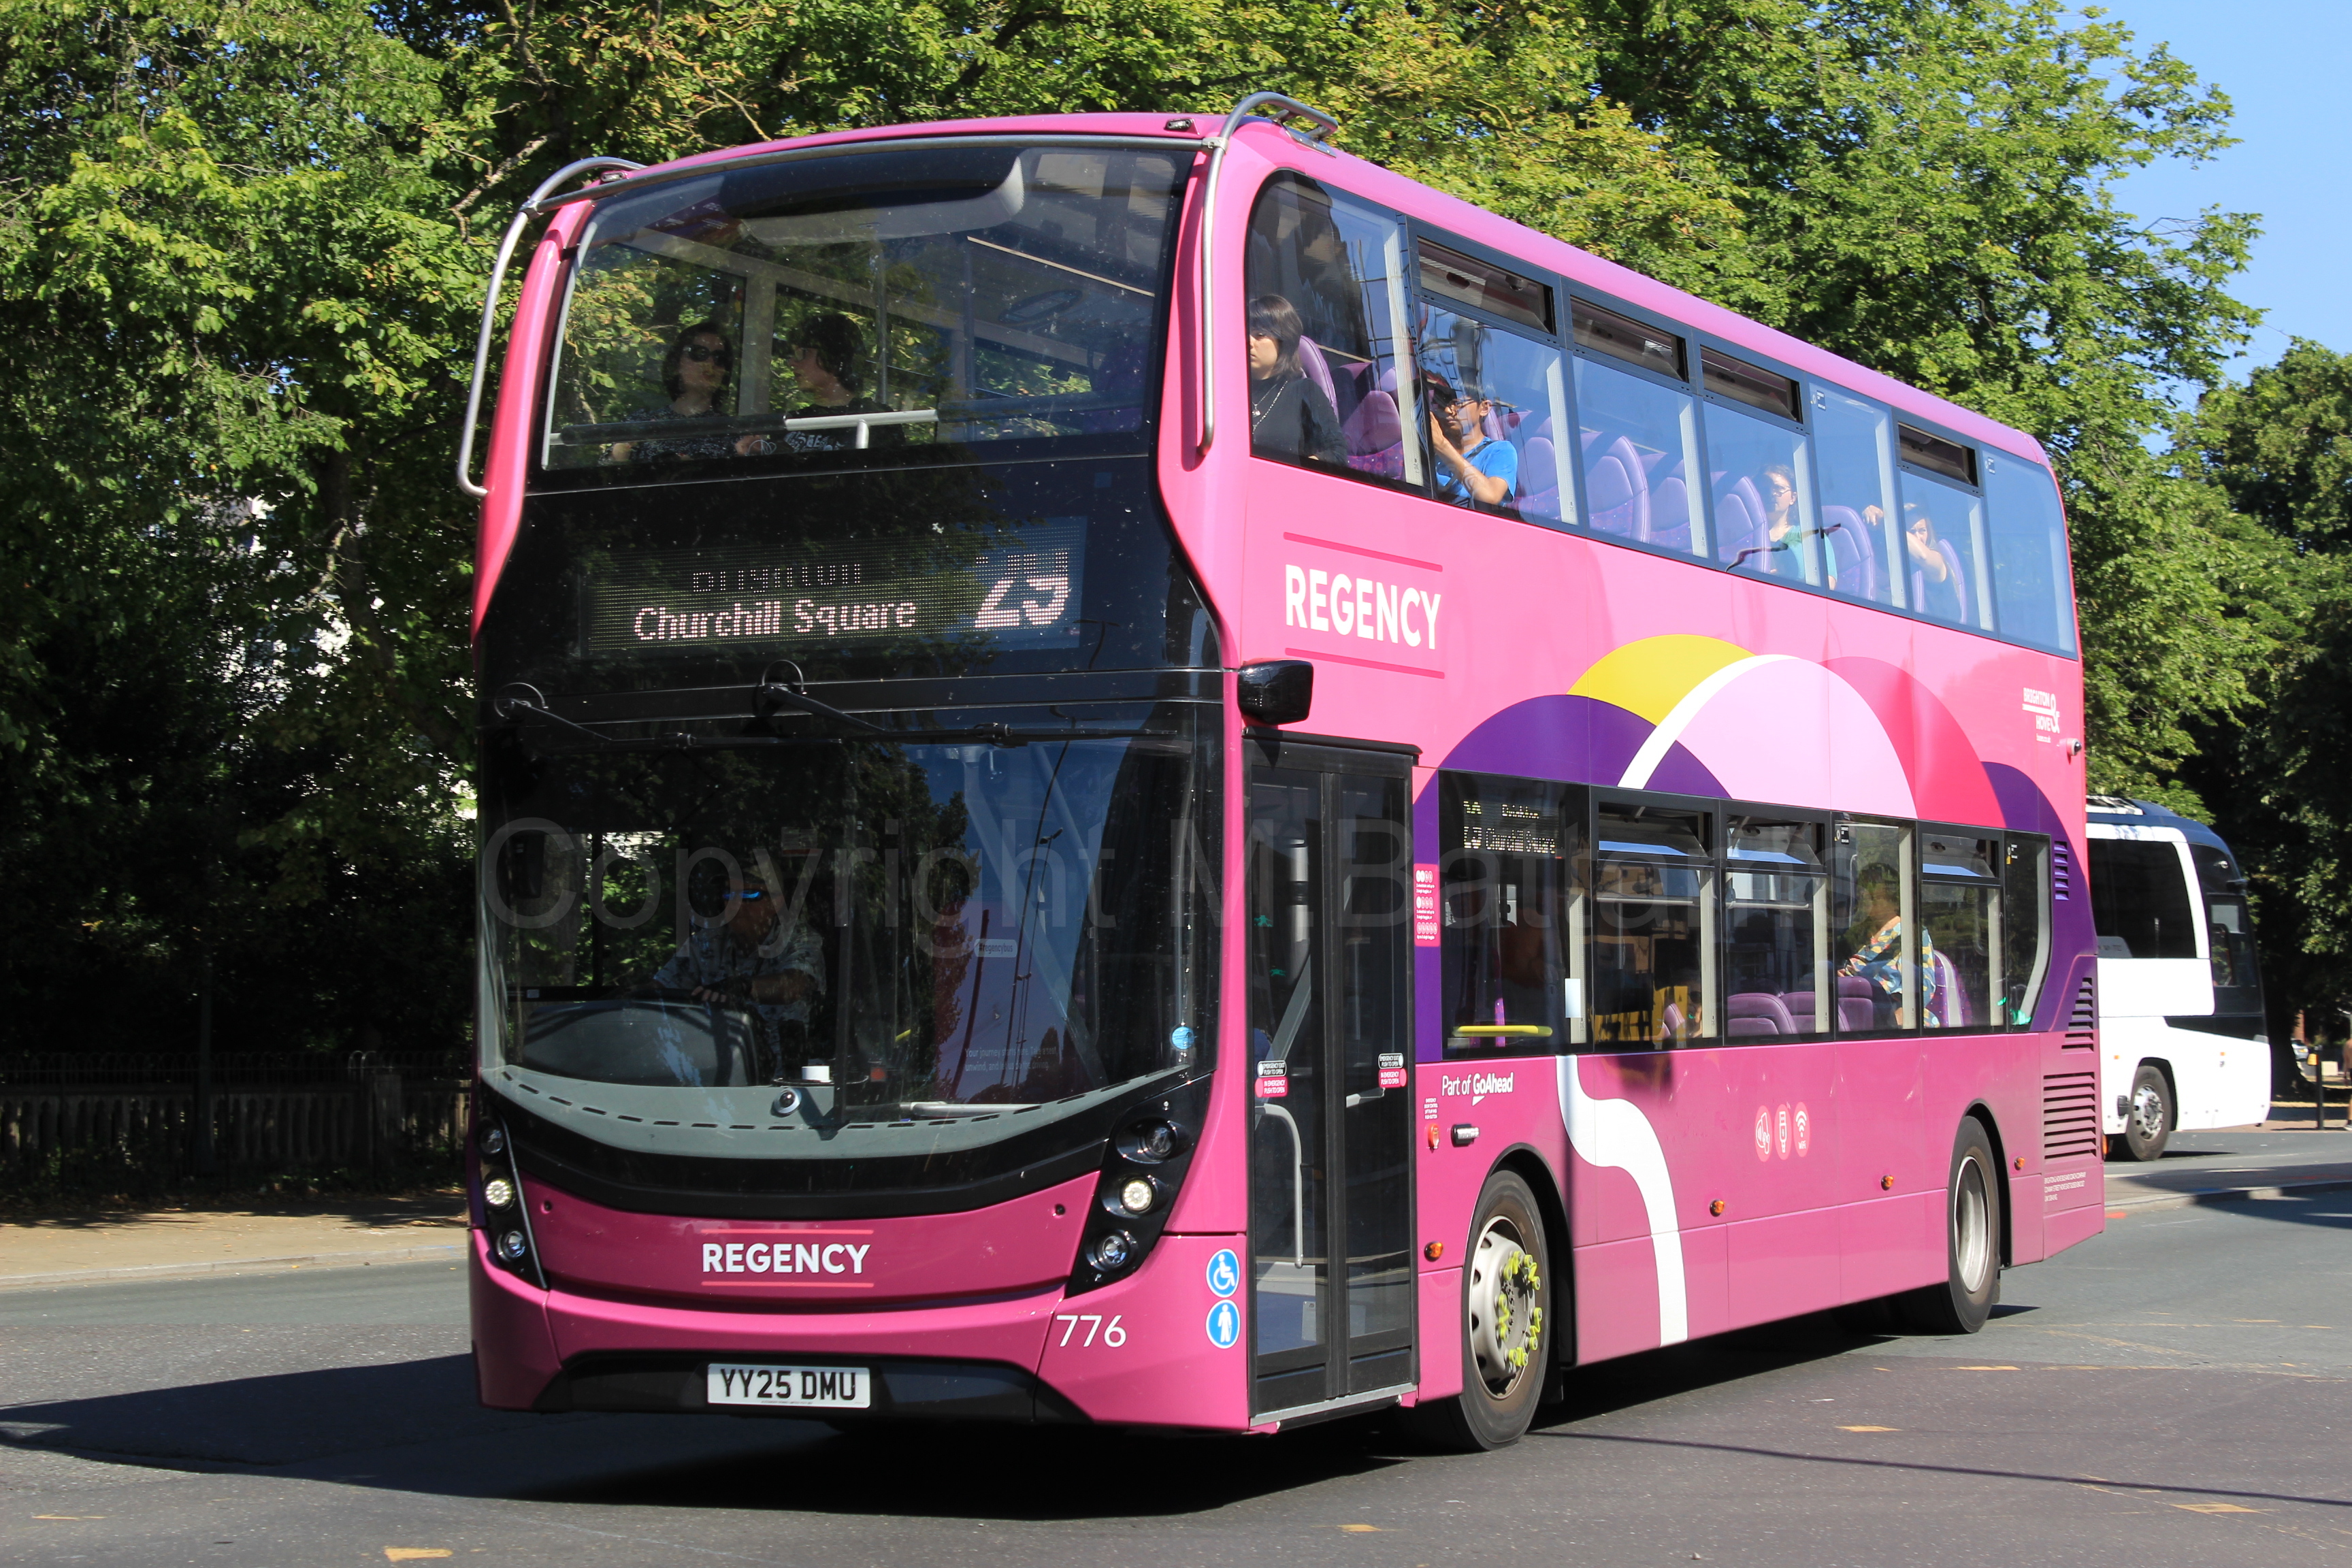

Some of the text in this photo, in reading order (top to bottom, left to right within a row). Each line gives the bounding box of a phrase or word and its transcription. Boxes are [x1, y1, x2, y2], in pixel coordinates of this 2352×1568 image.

[634, 599, 917, 640] Churchill Square
[1285, 564, 1441, 650] REGENCY
[1441, 1072, 1514, 1096] Part of GoAhead
[702, 1243, 870, 1274] REGENCY
[1056, 1314, 1127, 1348] 776
[720, 1368, 856, 1401] YY25 DMU
